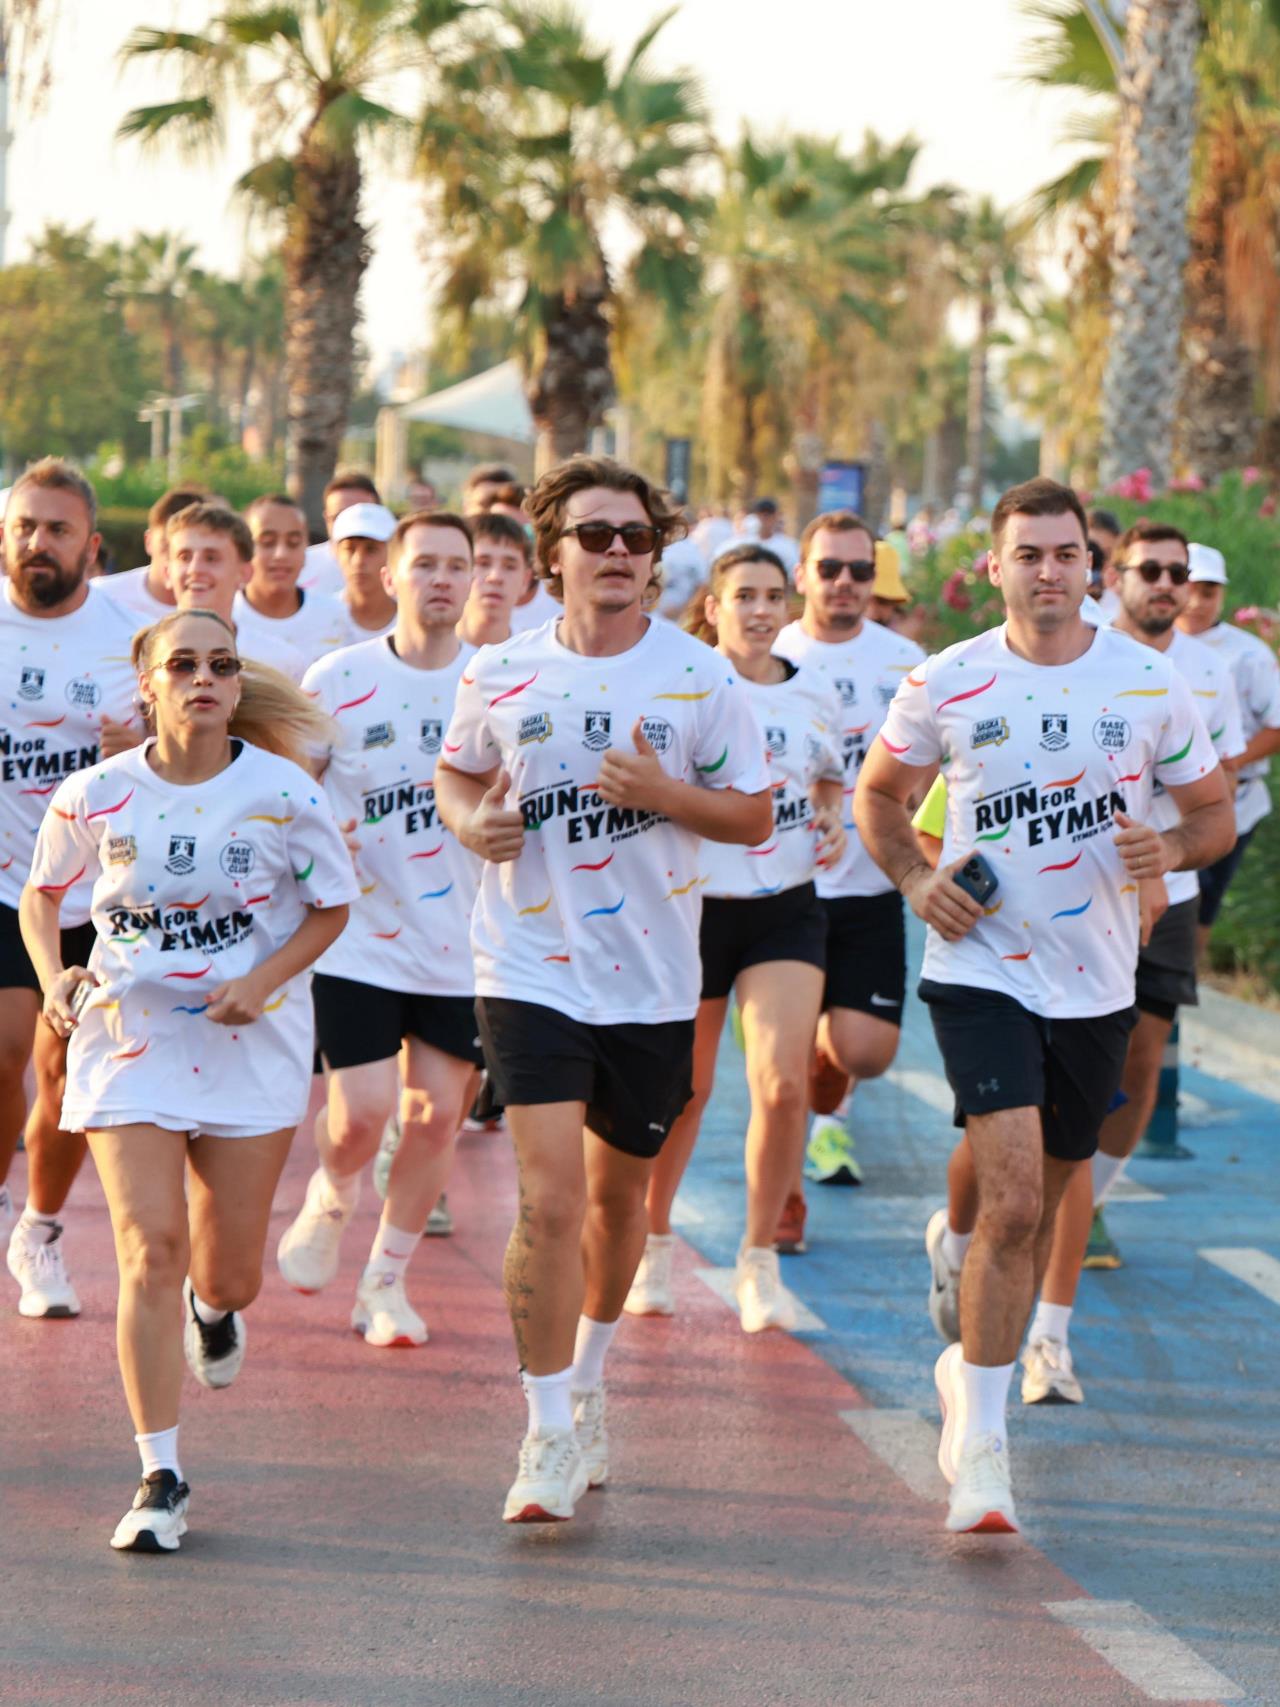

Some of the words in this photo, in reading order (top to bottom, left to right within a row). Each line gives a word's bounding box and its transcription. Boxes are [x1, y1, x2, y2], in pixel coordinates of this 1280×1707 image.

[643, 721, 668, 733] BASE
[1101, 721, 1124, 730] BASE
[648, 732, 666, 741] RUN
[1105, 730, 1124, 738] RUN
[14, 739, 45, 754] FOR
[650, 741, 666, 750] LUB
[1102, 738, 1124, 747] CLUB
[3, 745, 98, 781] EYMEN
[364, 785, 415, 820] RUN
[417, 788, 435, 804] FO
[520, 786, 578, 828] RUN
[581, 791, 609, 810] FO
[976, 787, 1037, 832] RUN
[1040, 787, 1075, 811] FOR
[568, 806, 659, 843] EYM
[1028, 791, 1127, 847] EYMEN
[228, 846, 250, 855] BASE
[232, 855, 249, 864] RUN
[228, 865, 249, 874] CLUB
[165, 911, 198, 930] FOR
